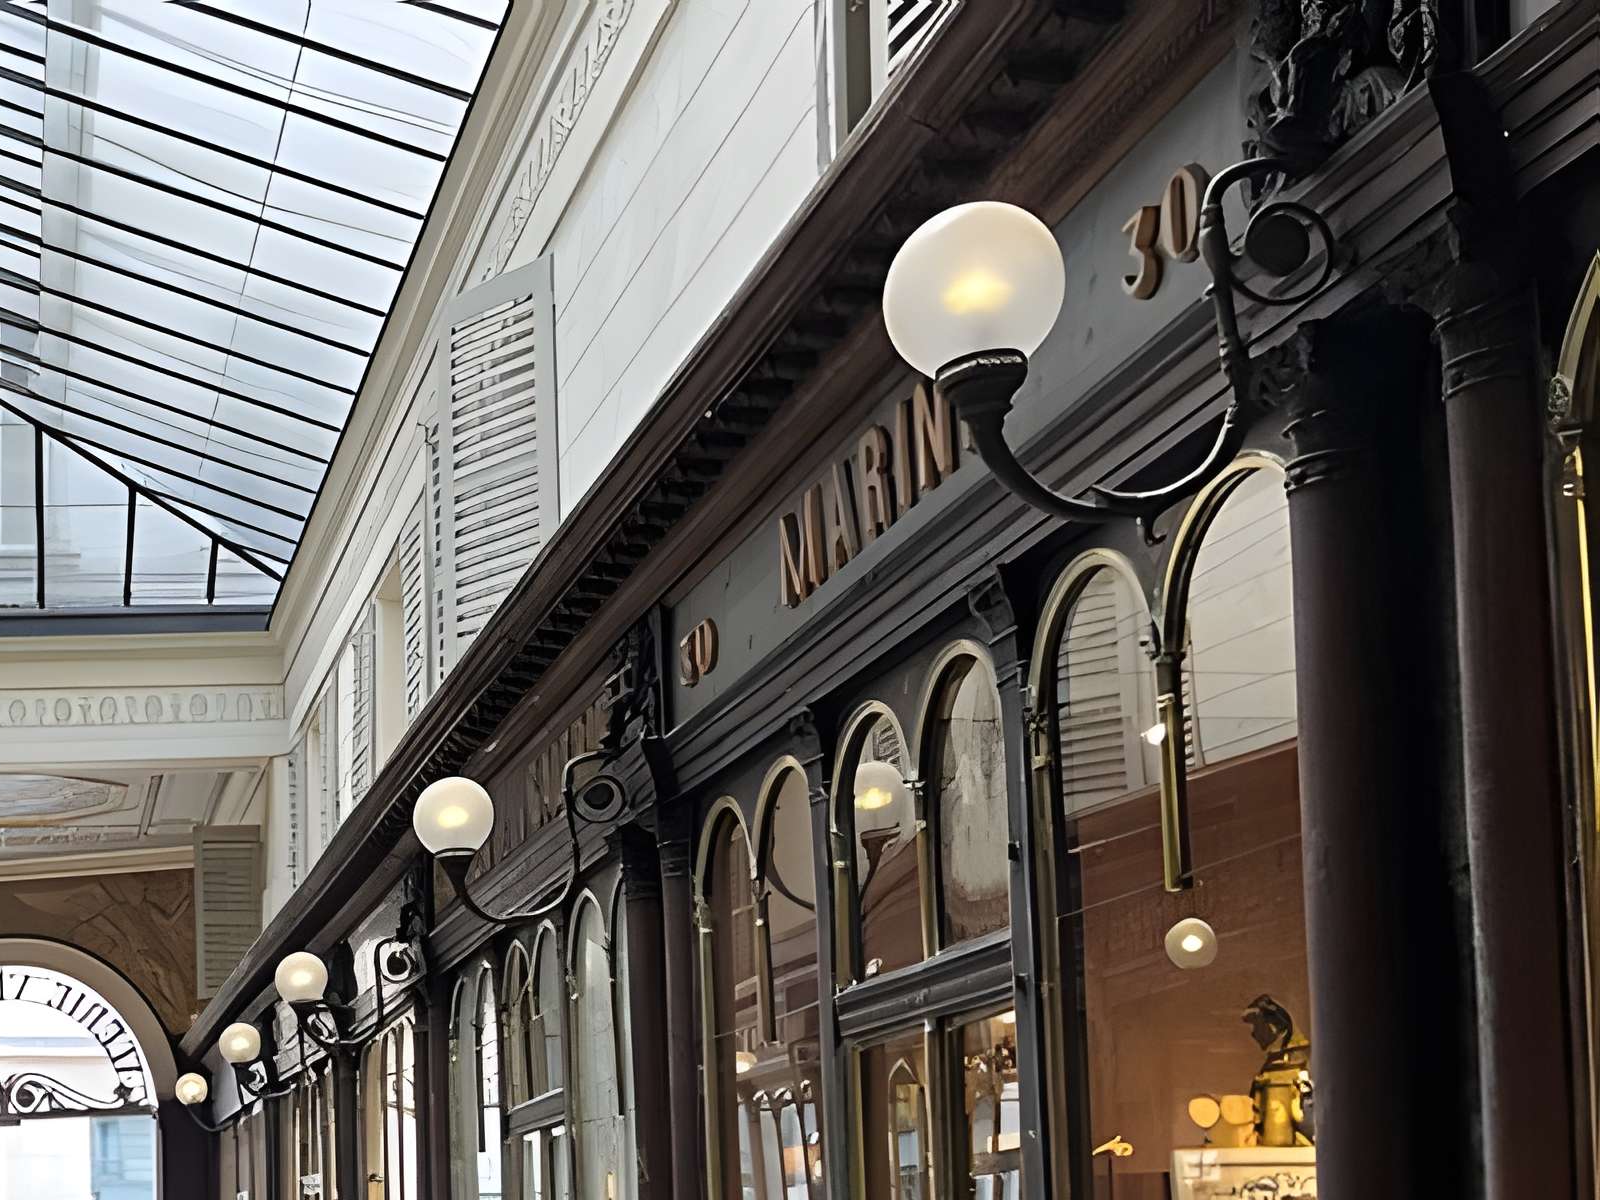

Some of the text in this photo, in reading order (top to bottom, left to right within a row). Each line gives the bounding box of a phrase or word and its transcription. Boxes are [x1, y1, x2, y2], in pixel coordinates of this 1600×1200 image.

[1121, 163, 1210, 300] 30
[778, 382, 980, 608] MARIN
[680, 617, 719, 688] 30
